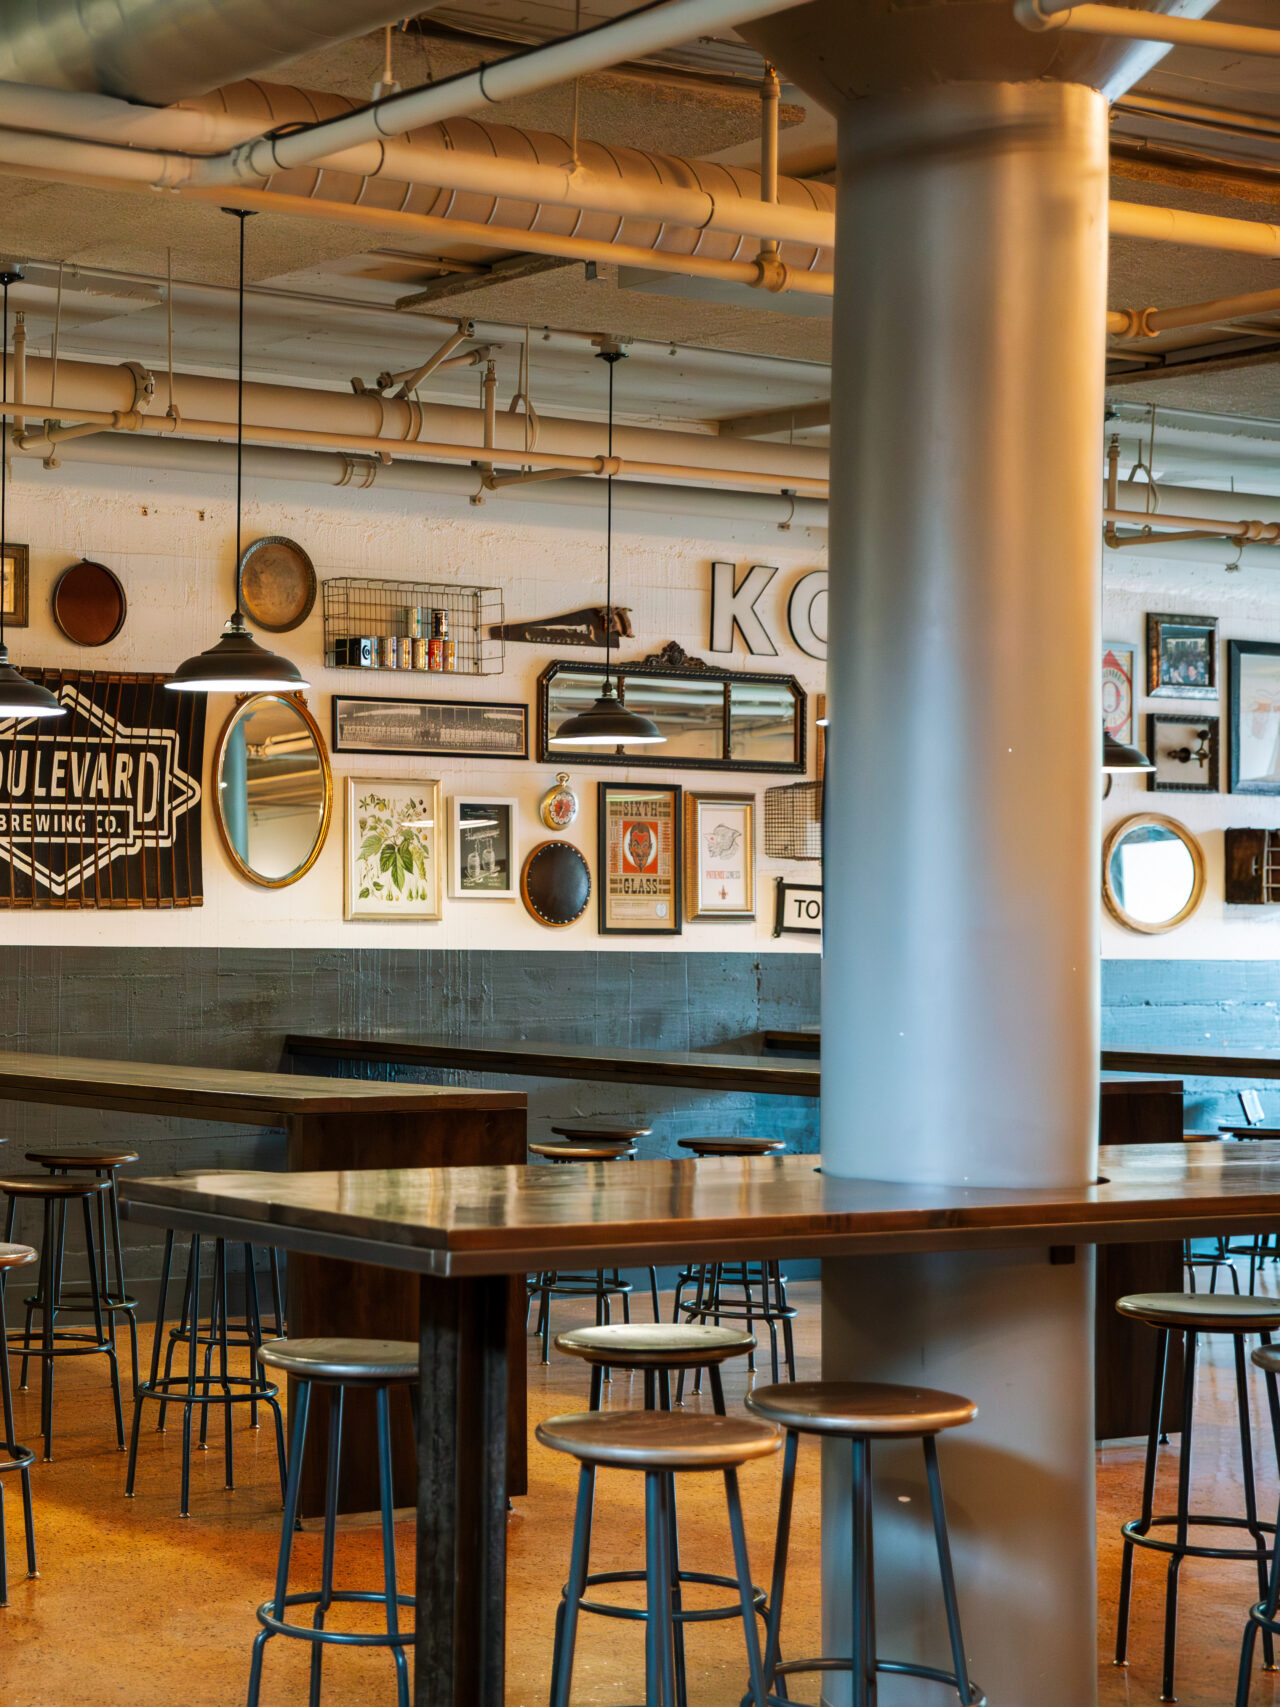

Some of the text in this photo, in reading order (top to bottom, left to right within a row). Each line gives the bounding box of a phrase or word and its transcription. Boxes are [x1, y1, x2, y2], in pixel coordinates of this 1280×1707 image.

[624, 801, 658, 817] SIXTH
[95, 815, 122, 833] CO.
[624, 878, 658, 895] GLASS
[793, 899, 821, 919] TO
